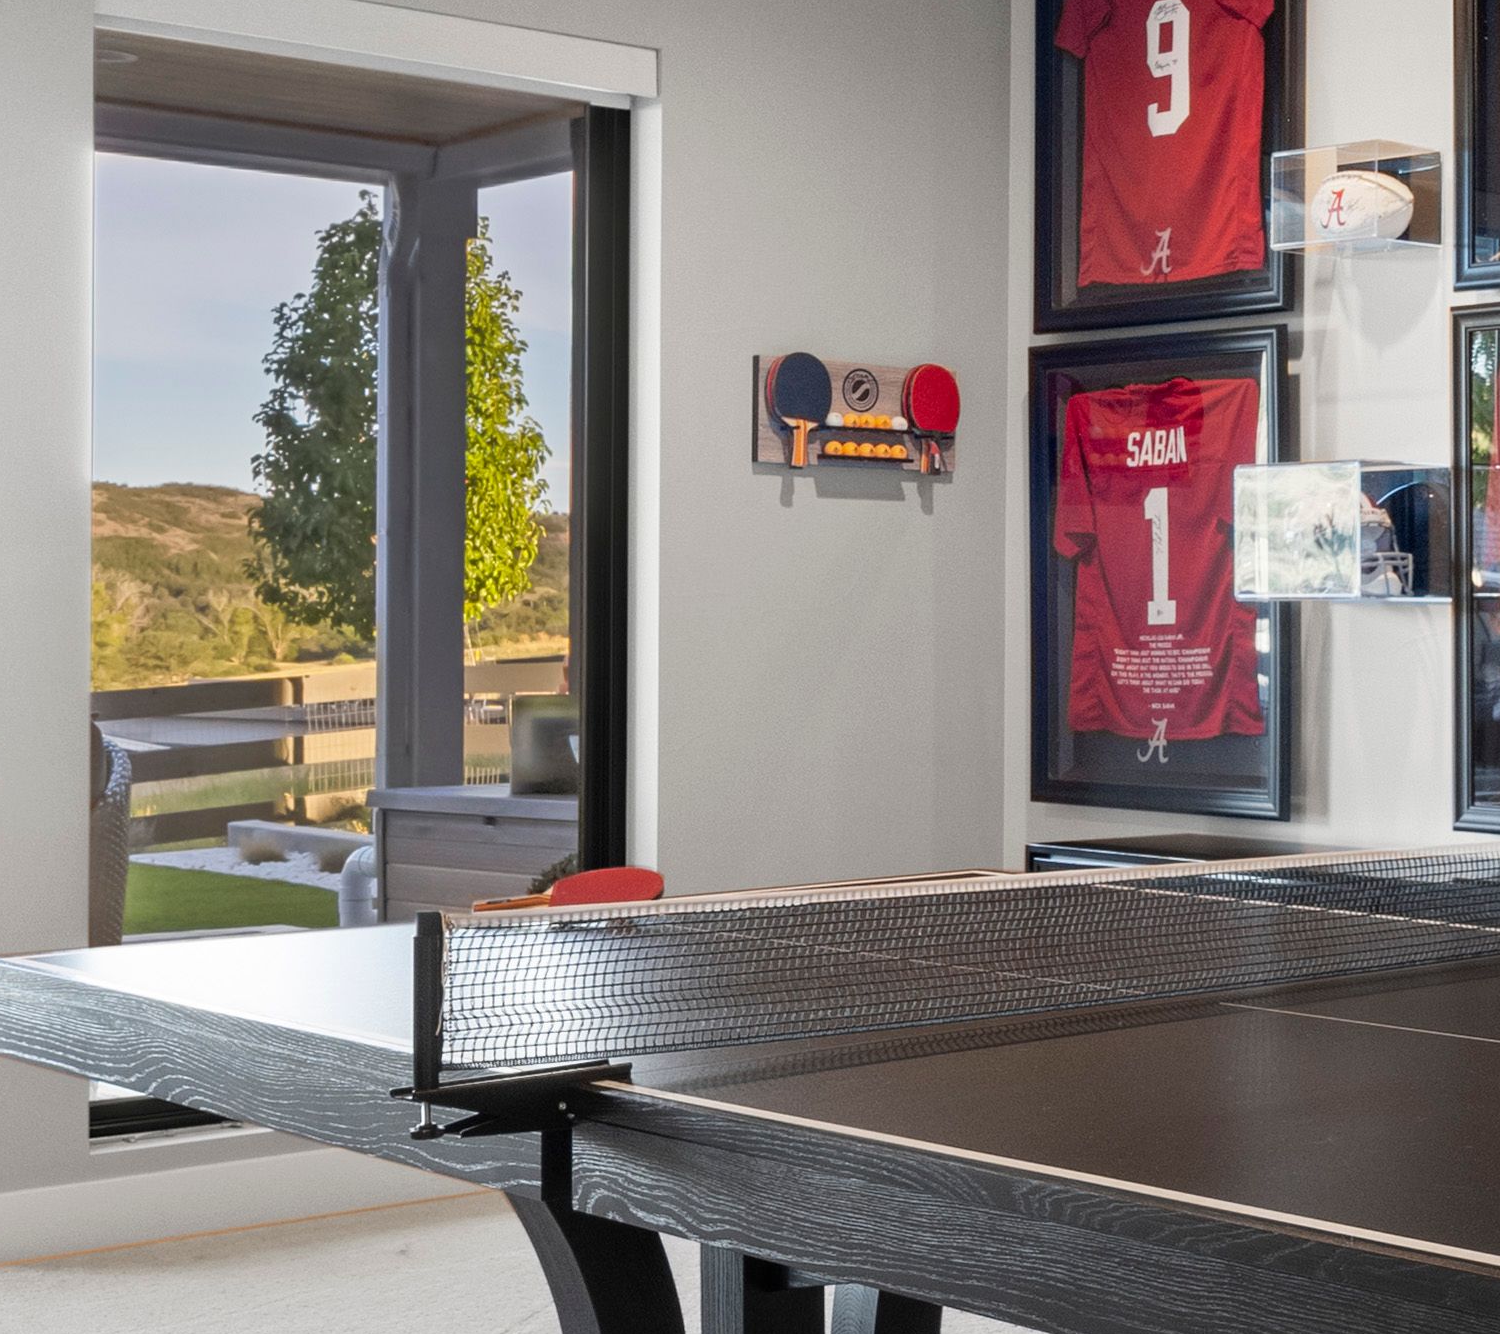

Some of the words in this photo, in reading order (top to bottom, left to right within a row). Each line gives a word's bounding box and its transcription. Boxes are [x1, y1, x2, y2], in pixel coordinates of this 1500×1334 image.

[1320, 189, 1346, 229] A
[1141, 228, 1173, 275] A
[1126, 426, 1187, 467] SABAN
[1143, 487, 1176, 625] 1
[1138, 717, 1169, 763] A
